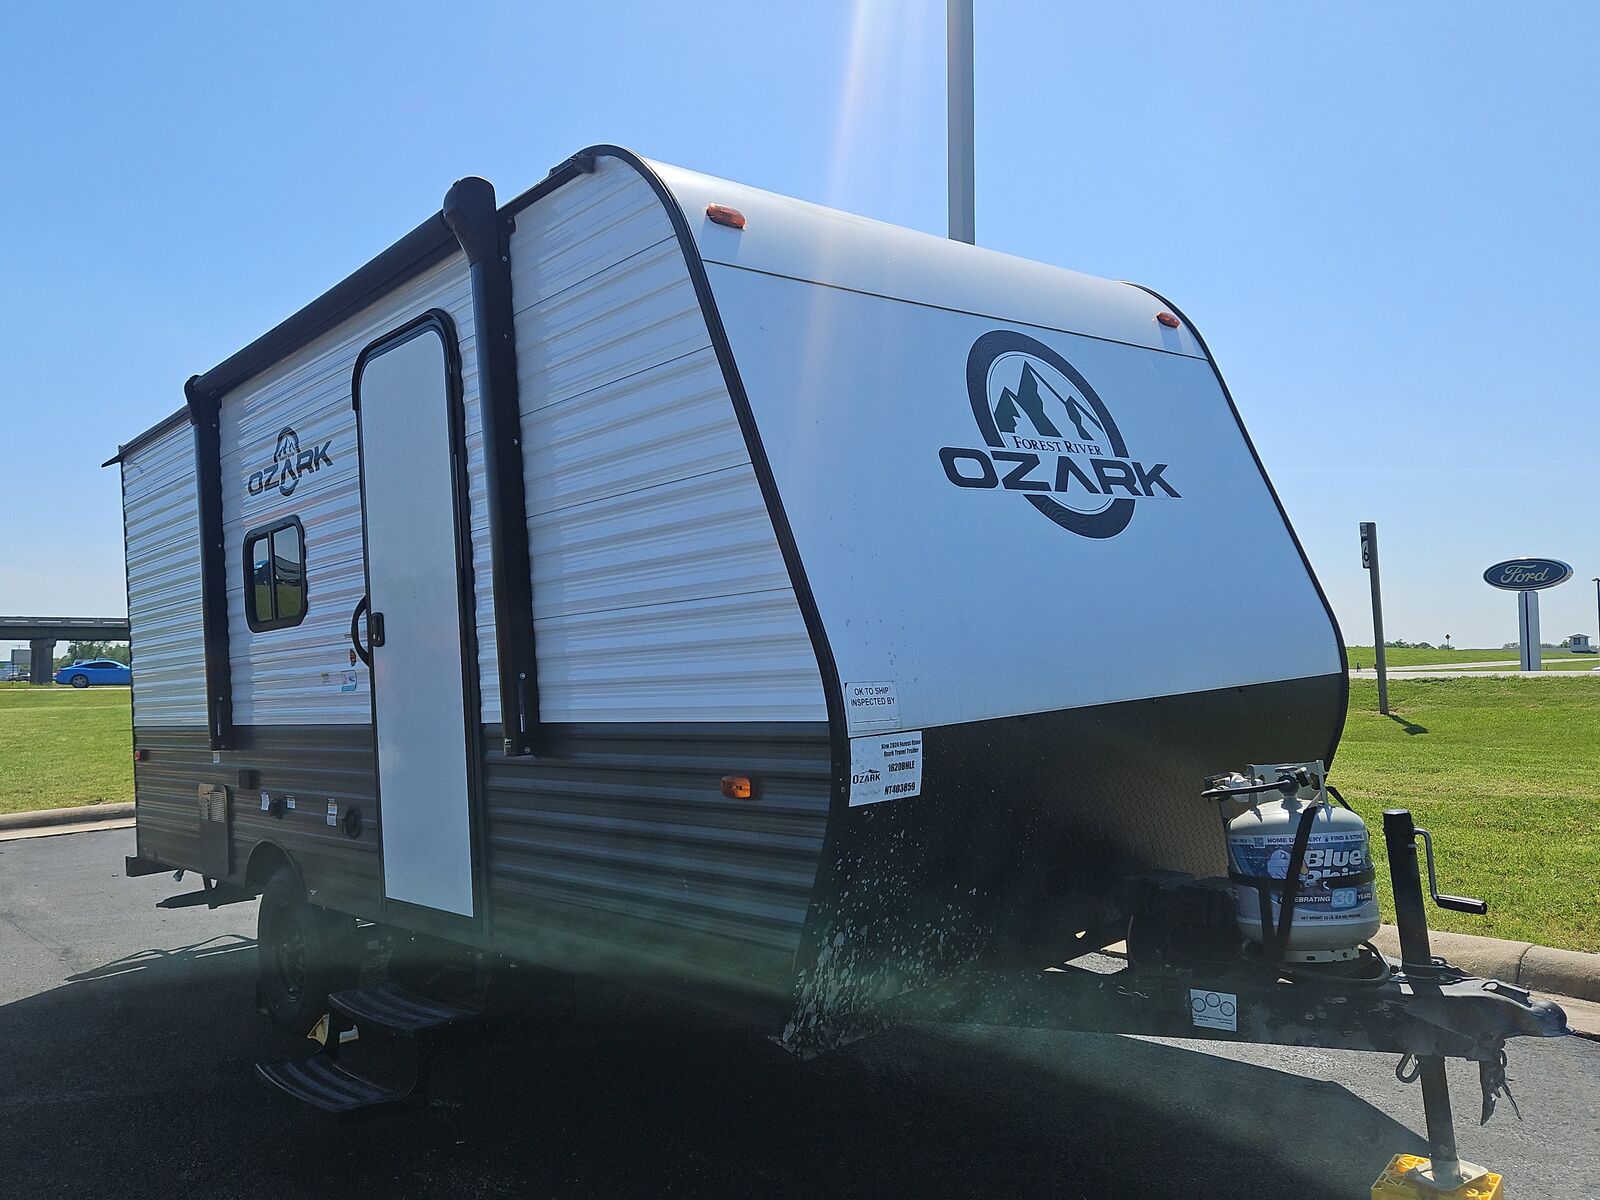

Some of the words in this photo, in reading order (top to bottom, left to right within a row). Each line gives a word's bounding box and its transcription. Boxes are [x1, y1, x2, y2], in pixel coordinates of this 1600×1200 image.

[1012, 435, 1062, 452] FOREST
[1065, 441, 1104, 455] RIVER
[247, 440, 333, 496] OZARK
[938, 446, 1182, 498] OZARK
[1500, 564, 1549, 584] Ford
[854, 688, 864, 696] OK
[865, 687, 874, 695] TO
[875, 686, 889, 695] SHIP
[851, 698, 885, 707] INSPECTED
[887, 697, 895, 705] BY
[852, 773, 881, 784] OZARK
[1303, 849, 1361, 867] Blue
[1333, 890, 1355, 906] 30
